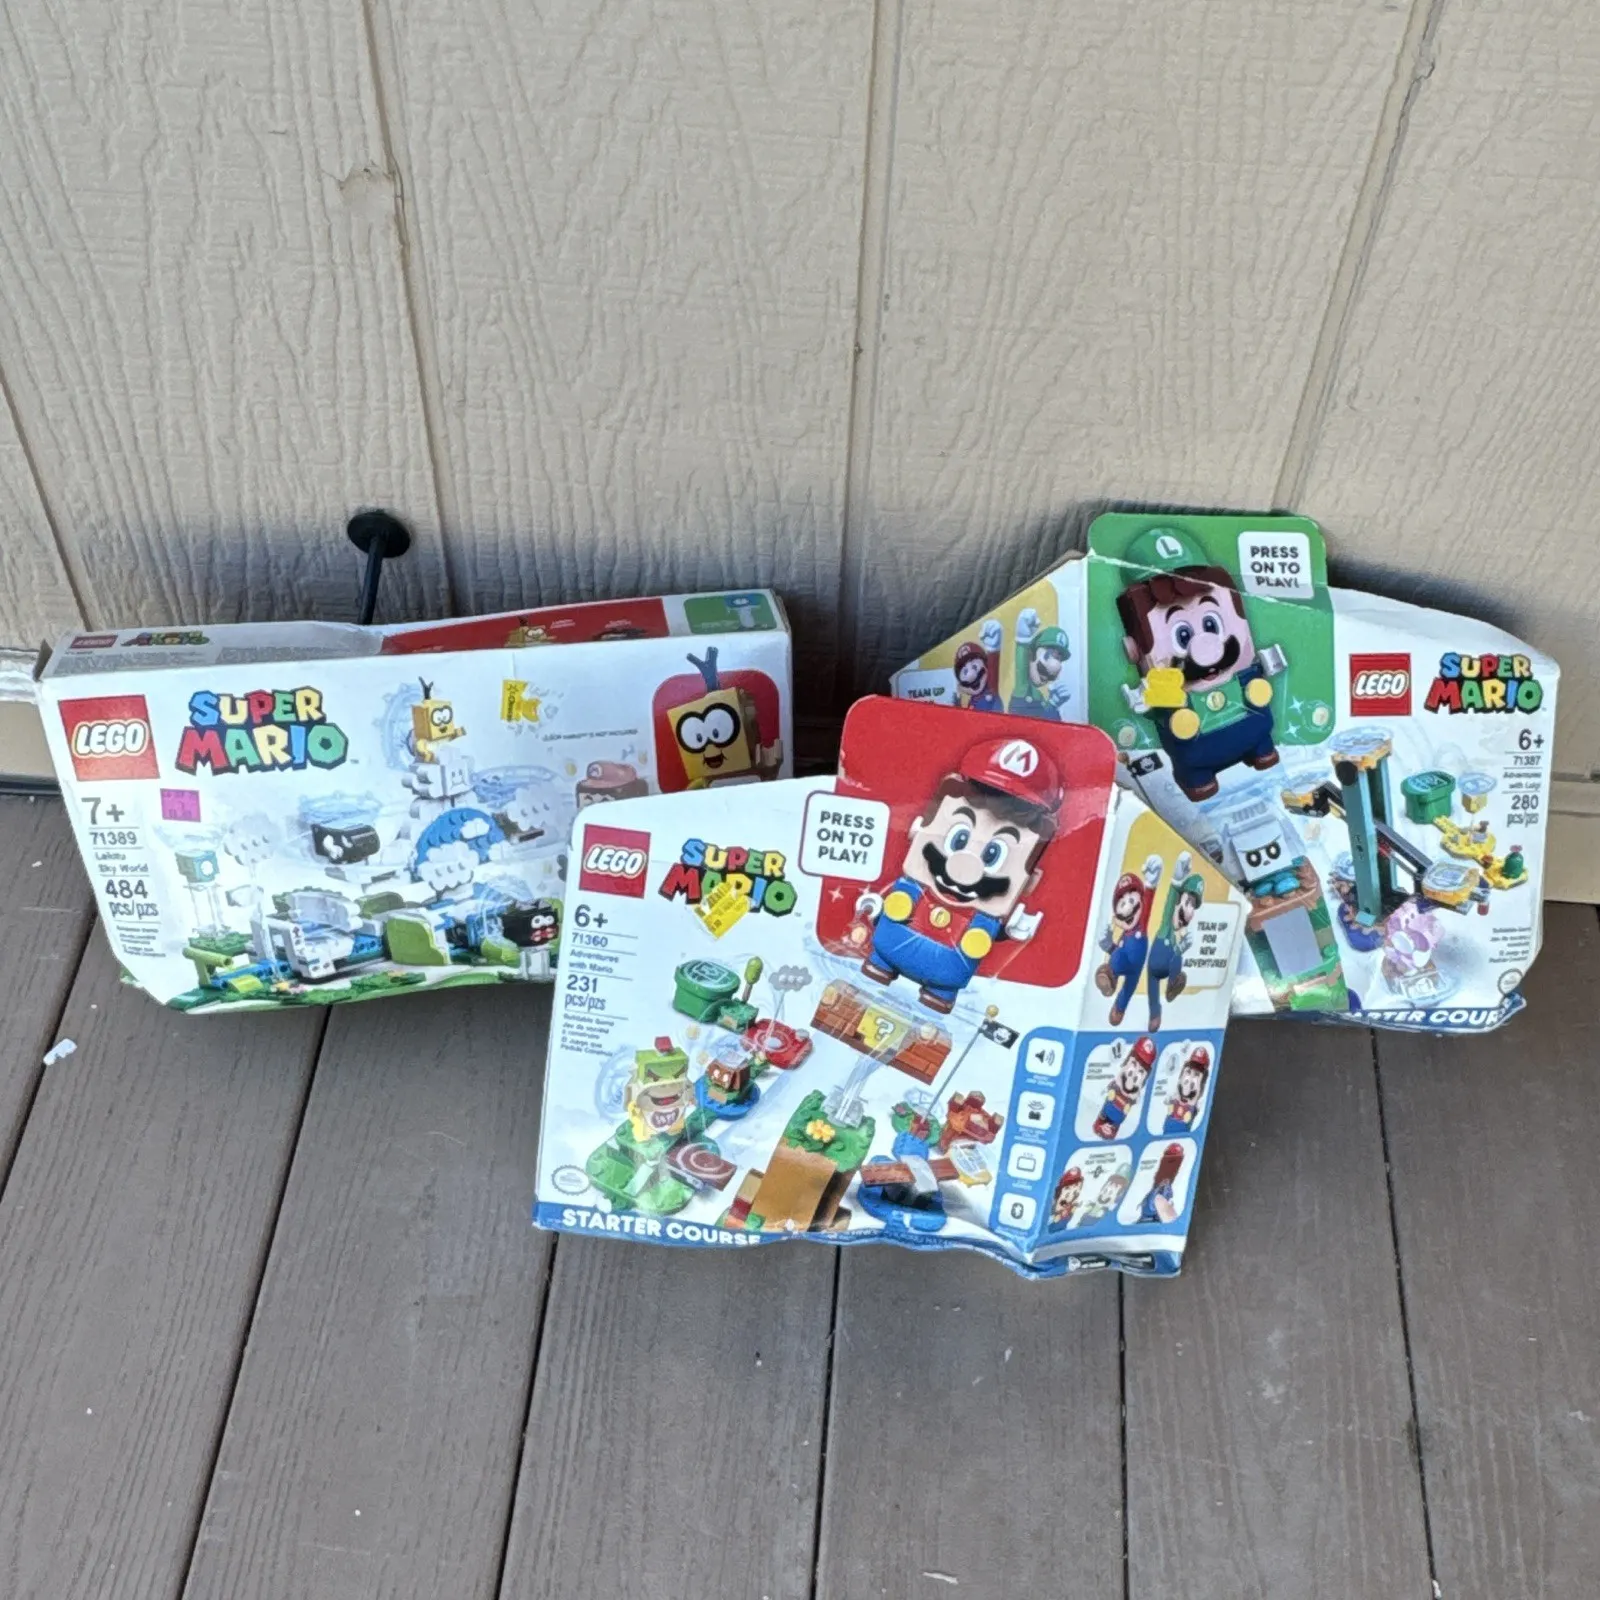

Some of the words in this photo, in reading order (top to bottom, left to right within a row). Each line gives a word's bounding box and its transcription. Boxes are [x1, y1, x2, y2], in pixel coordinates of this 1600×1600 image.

[1250, 545, 1299, 559] PRESS
[1250, 560, 1275, 574] ON
[1278, 562, 1300, 574] TO
[1439, 652, 1533, 679] SUPER
[932, 686, 945, 697] UP
[1353, 670, 1408, 698] LEGO
[189, 685, 327, 726] SUPER
[1424, 677, 1543, 715] MARIO
[73, 719, 149, 757] LEGO
[1518, 728, 1545, 751] 6+
[175, 722, 349, 777] MARIO
[1513, 755, 1541, 766] 71387
[81, 797, 124, 825] 7+
[1511, 794, 1539, 811] 280
[820, 810, 875, 830] PRESS
[89, 831, 137, 845] 71389
[817, 827, 845, 844] ON
[848, 831, 874, 847] TO
[584, 845, 646, 878] LEGO
[682, 838, 786, 878] SUPER
[818, 845, 868, 865] PLAY!
[105, 879, 148, 899] 484
[575, 903, 609, 929] 6+
[1197, 922, 1216, 931] TEAM
[1218, 922, 1228, 931] UP
[572, 932, 608, 947] 71360
[1202, 934, 1216, 943] FOR
[570, 949, 619, 963] Adventures
[1199, 947, 1216, 956] NEW
[567, 974, 598, 994] 231
[564, 993, 607, 1013] pcs/pzs
[562, 1208, 662, 1238] STARTER
